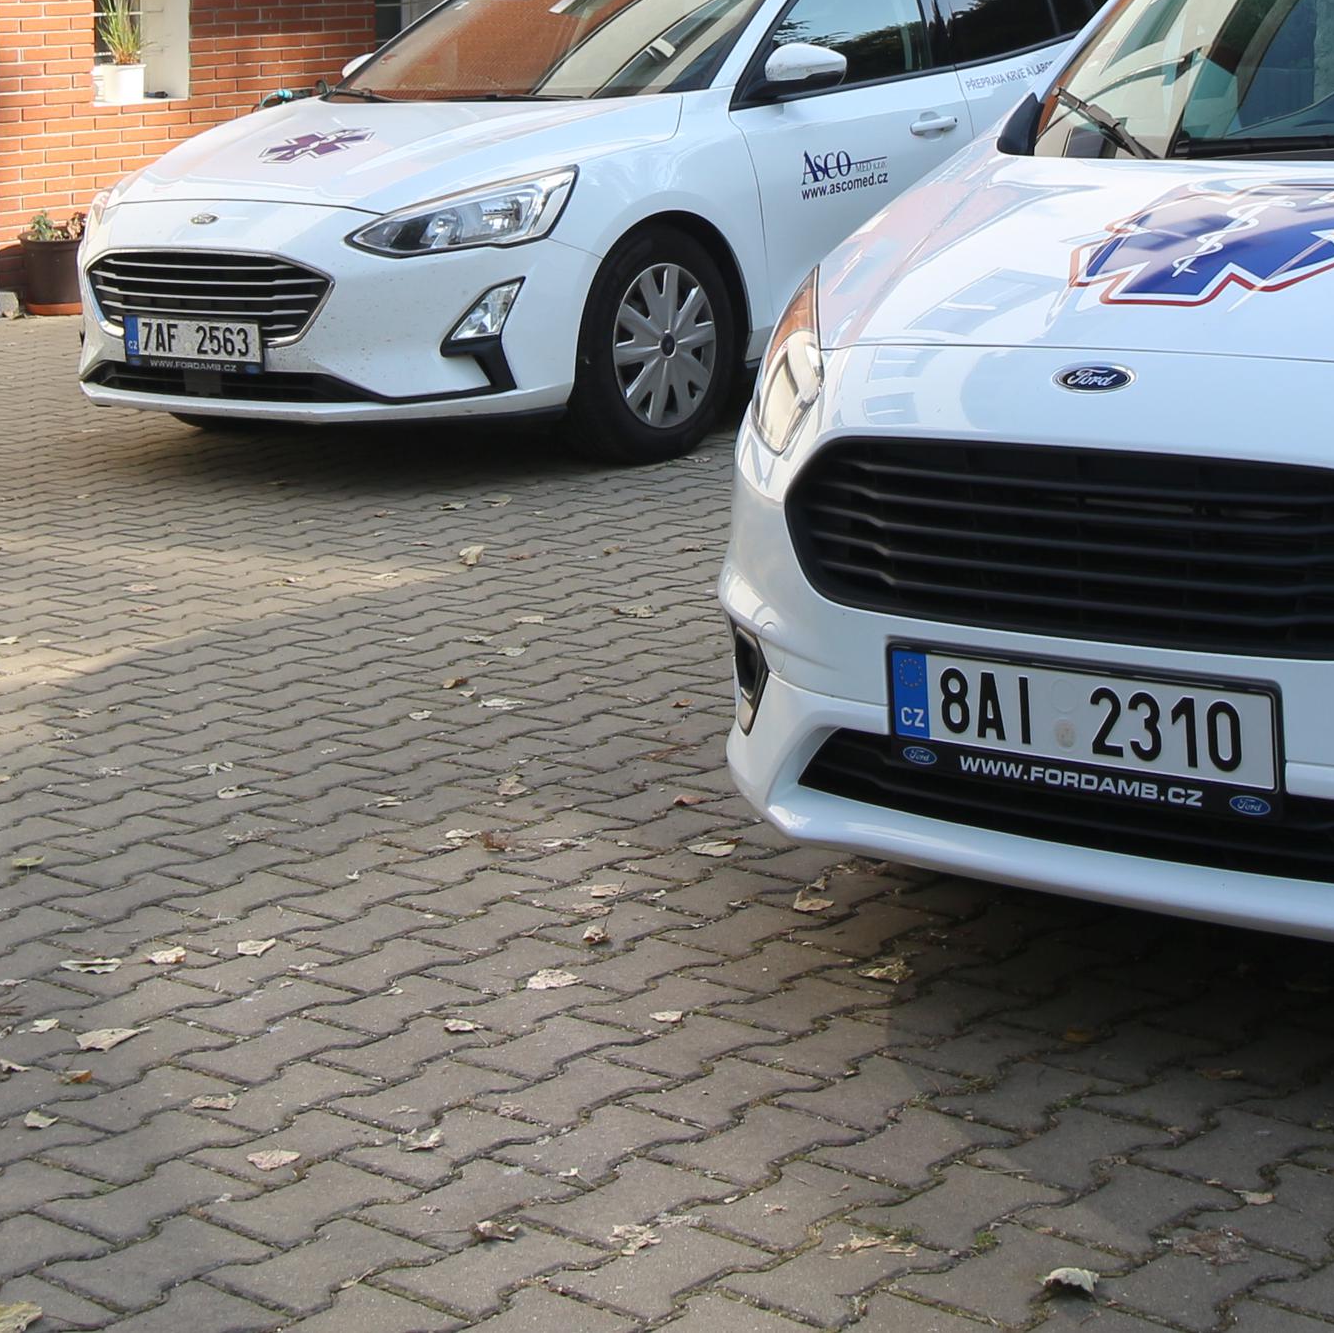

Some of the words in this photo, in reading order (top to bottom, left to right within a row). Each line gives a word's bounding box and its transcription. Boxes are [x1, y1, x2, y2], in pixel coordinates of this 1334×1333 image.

[801, 172, 889, 200] www.ascomed.cz
[128, 340, 138, 350] CZ
[141, 321, 178, 353] 7AF
[195, 325, 249, 357] 2563
[1067, 368, 1117, 386] Ford
[901, 706, 925, 727] CZ
[939, 666, 1032, 745] 8AI
[1089, 685, 1243, 772] 2310
[959, 754, 1203, 807] WWW.FORDAMB.CZ
[1237, 798, 1263, 812] Ford
